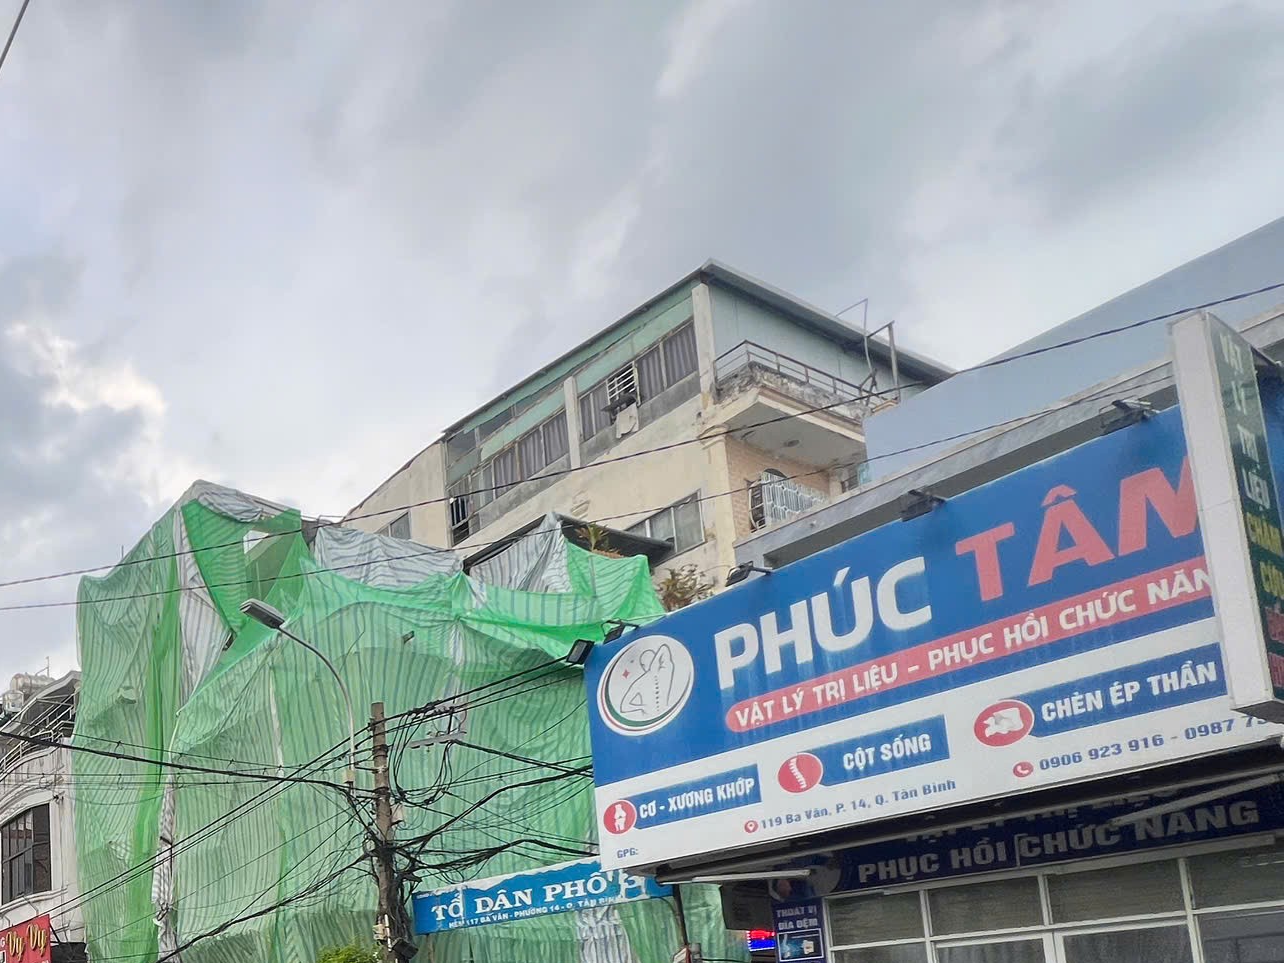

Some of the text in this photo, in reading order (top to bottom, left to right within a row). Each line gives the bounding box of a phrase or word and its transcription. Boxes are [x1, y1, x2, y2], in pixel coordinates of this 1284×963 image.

[714, 456, 1201, 691] PHÚC TÂM
[734, 700, 775, 729] VẬT
[782, 690, 805, 713] LÝ
[811, 679, 846, 703] TRỊ
[853, 662, 899, 693] LIỆU
[928, 632, 995, 673] PHỤC
[1002, 613, 1050, 651] HỒI
[1059, 587, 1137, 632] CHỨC
[1040, 690, 1105, 723] CHÈN
[1109, 672, 1142, 706] ÉP
[842, 732, 933, 773] CỘT SỐNG
[1039, 750, 1084, 772] 0906
[1088, 741, 1124, 762] 923
[1128, 733, 1165, 753] 916
[1184, 717, 1236, 742] 0987
[639, 799, 658, 820] CƠ
[667, 786, 715, 814] XƯƠNG
[716, 776, 756, 803] KHỚP
[761, 816, 783, 830] 119
[785, 810, 803, 825] Ba
[835, 802, 848, 816] P.
[874, 793, 890, 809] Q.
[892, 785, 919, 803] Tân
[922, 778, 957, 798] Bình
[616, 846, 639, 860] GPG:
[857, 852, 941, 885] PHỤC
[949, 834, 1008, 871] HỒI
[1019, 820, 1122, 860] CHỨC
[430, 892, 465, 922] TỔ
[473, 888, 533, 917] DÂN
[543, 870, 615, 902] PHỐ
[466, 916, 480, 927] 117
[480, 913, 492, 924] BA
[492, 909, 509, 923] VÂN
[514, 904, 549, 919] PHƯỜNG
[550, 902, 561, 912] 14
